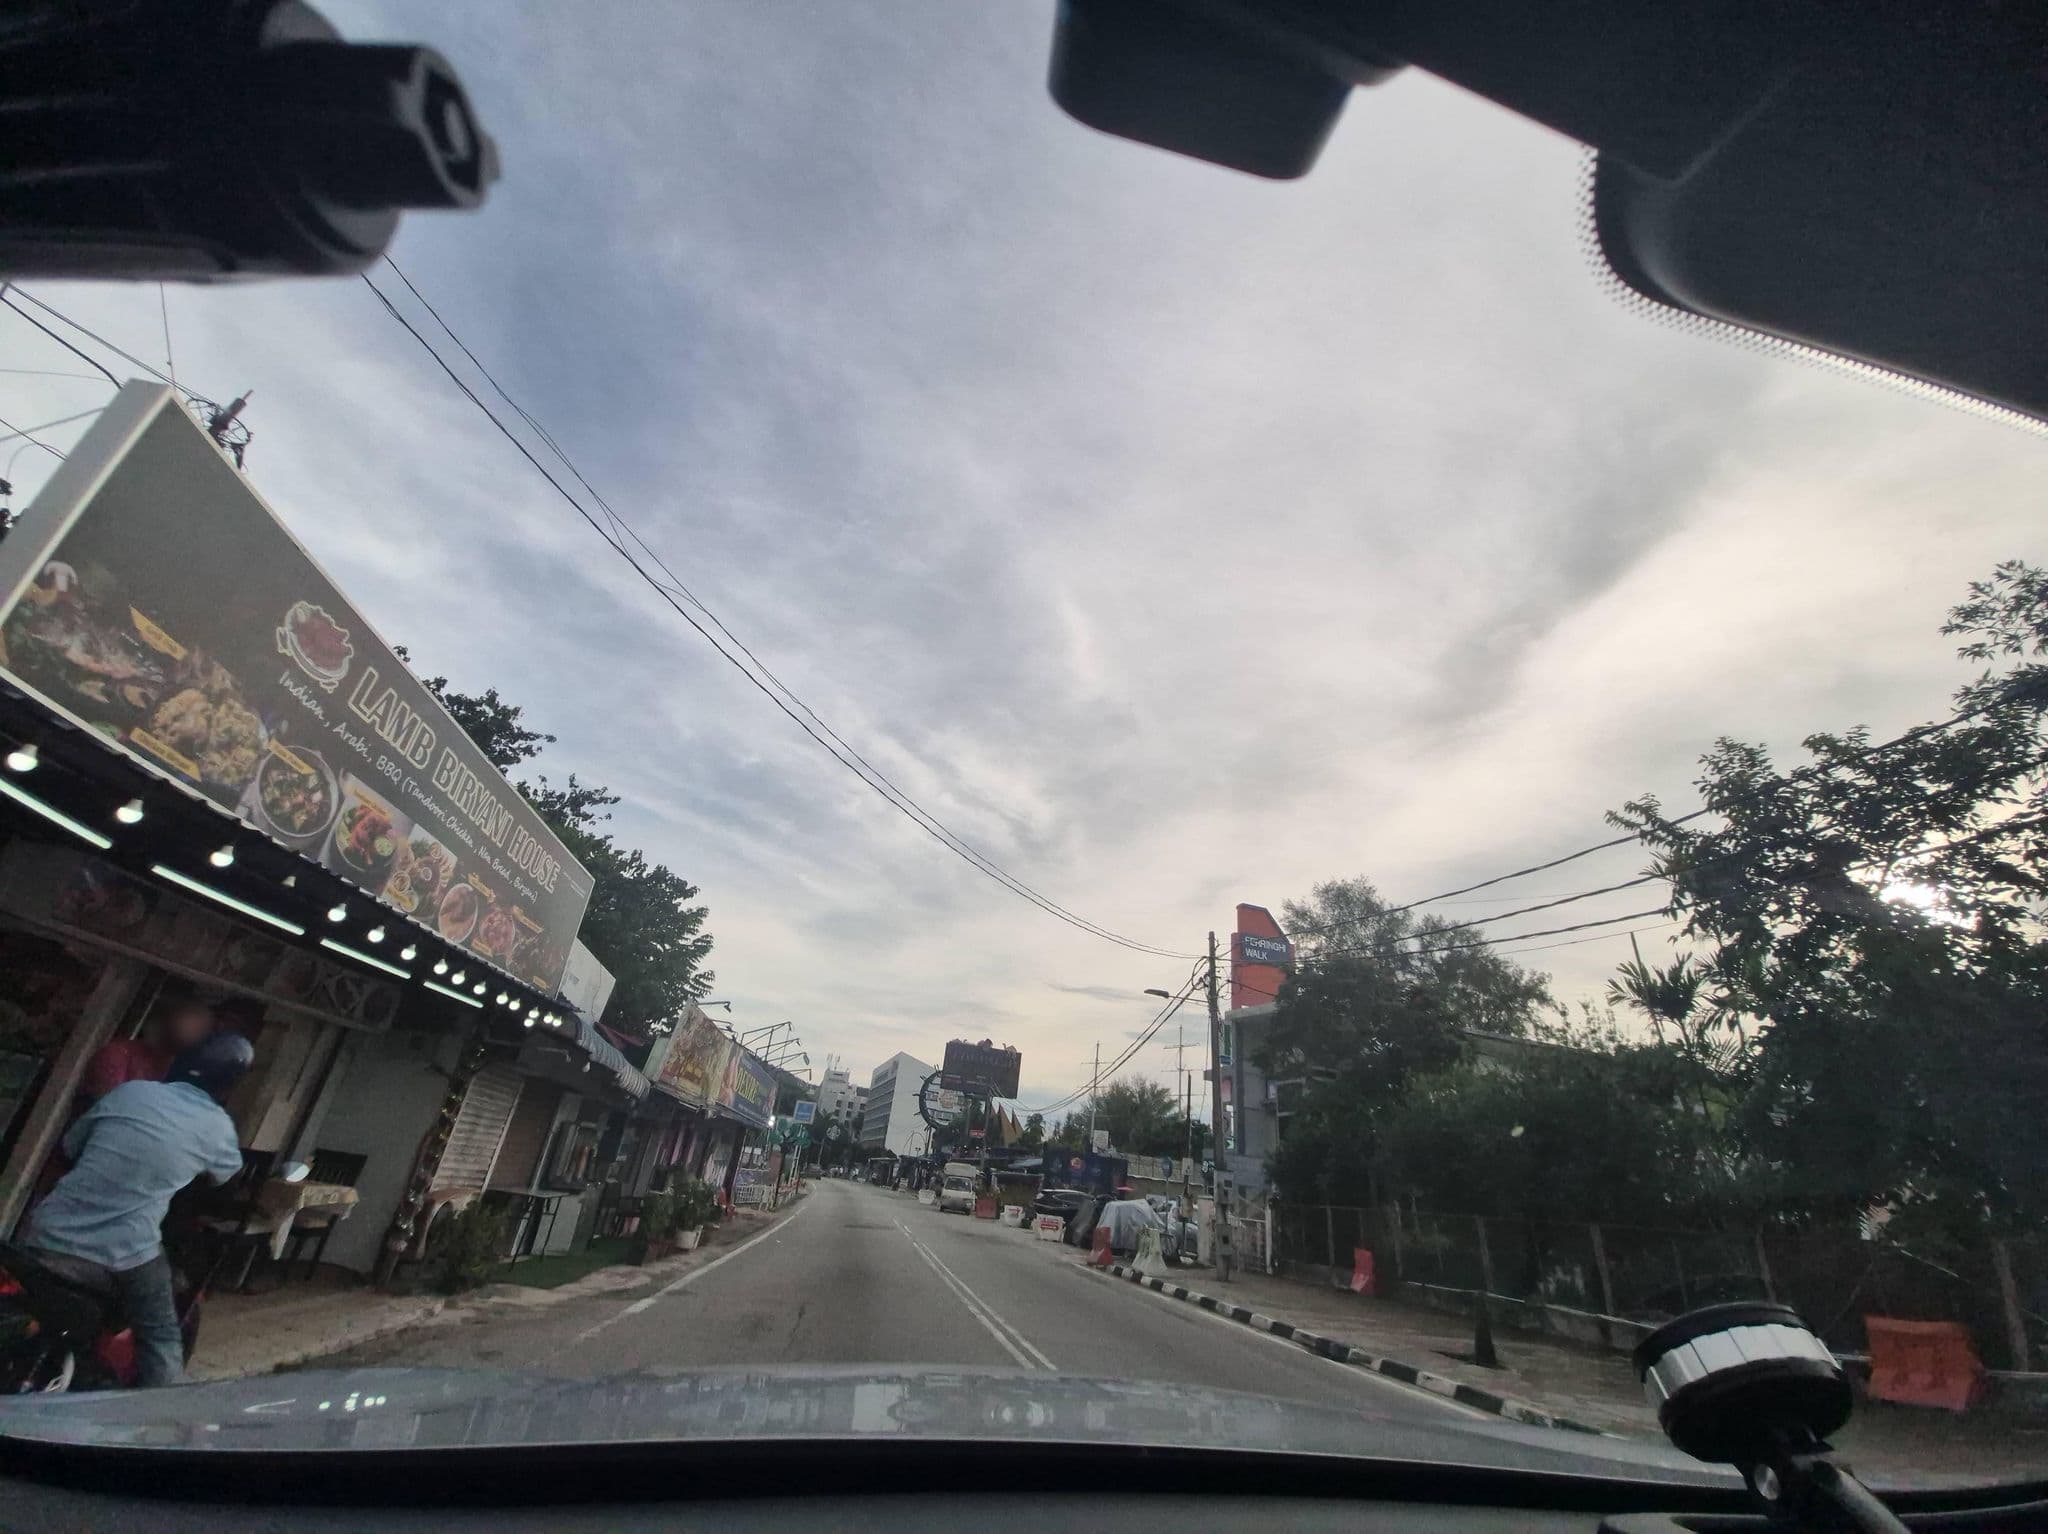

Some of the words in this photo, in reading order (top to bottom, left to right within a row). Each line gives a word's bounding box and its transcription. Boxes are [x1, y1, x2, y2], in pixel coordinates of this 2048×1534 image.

[348, 666, 436, 769] LAMB
[432, 746, 514, 848] BIRYANI
[507, 825, 560, 894] HOUSE
[376, 755, 401, 785] BBQ
[1245, 948, 1267, 961] WALK
